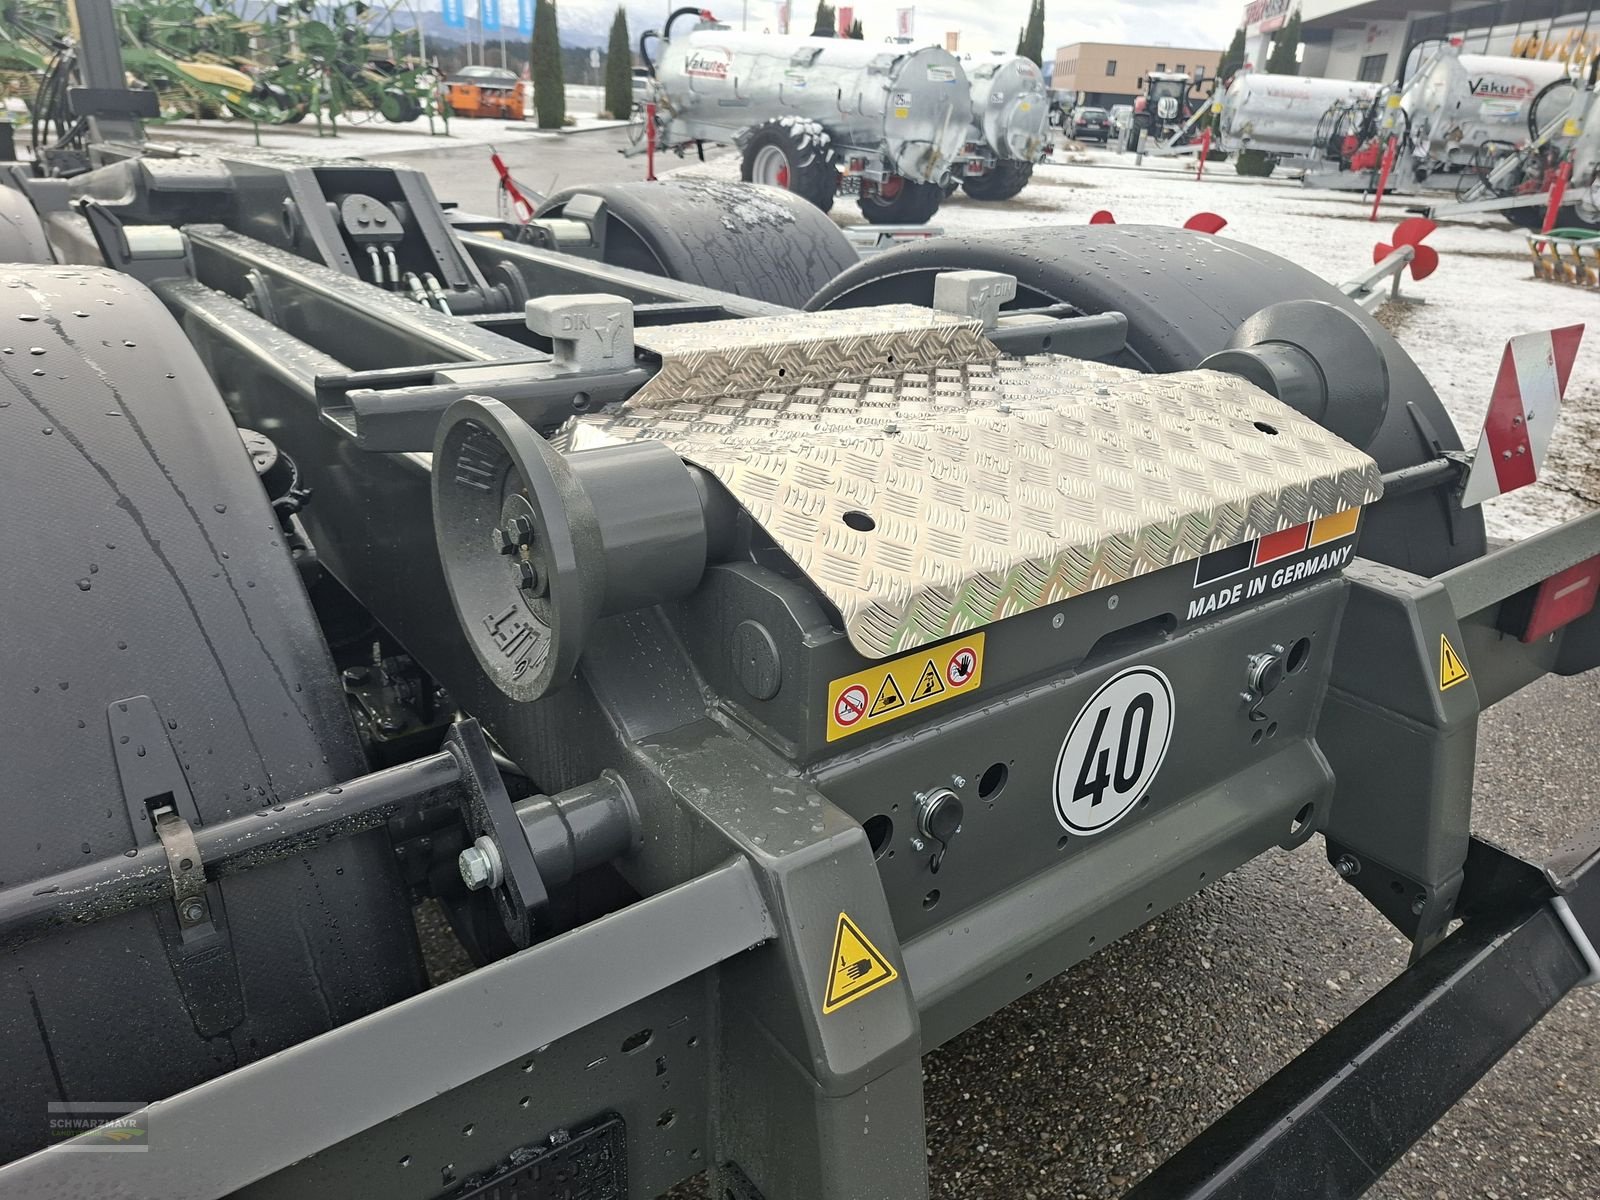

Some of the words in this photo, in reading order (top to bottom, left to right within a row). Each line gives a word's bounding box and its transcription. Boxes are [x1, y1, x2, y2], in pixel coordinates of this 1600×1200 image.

[685, 52, 728, 73] Vakutec
[1468, 78, 1534, 96] Vakutec
[994, 282, 1013, 297] DIN
[561, 313, 591, 331] DIN
[1186, 584, 1243, 621] MADE
[1246, 575, 1267, 599] IN
[1271, 544, 1353, 589] GERMANY
[1071, 692, 1154, 808] 40
